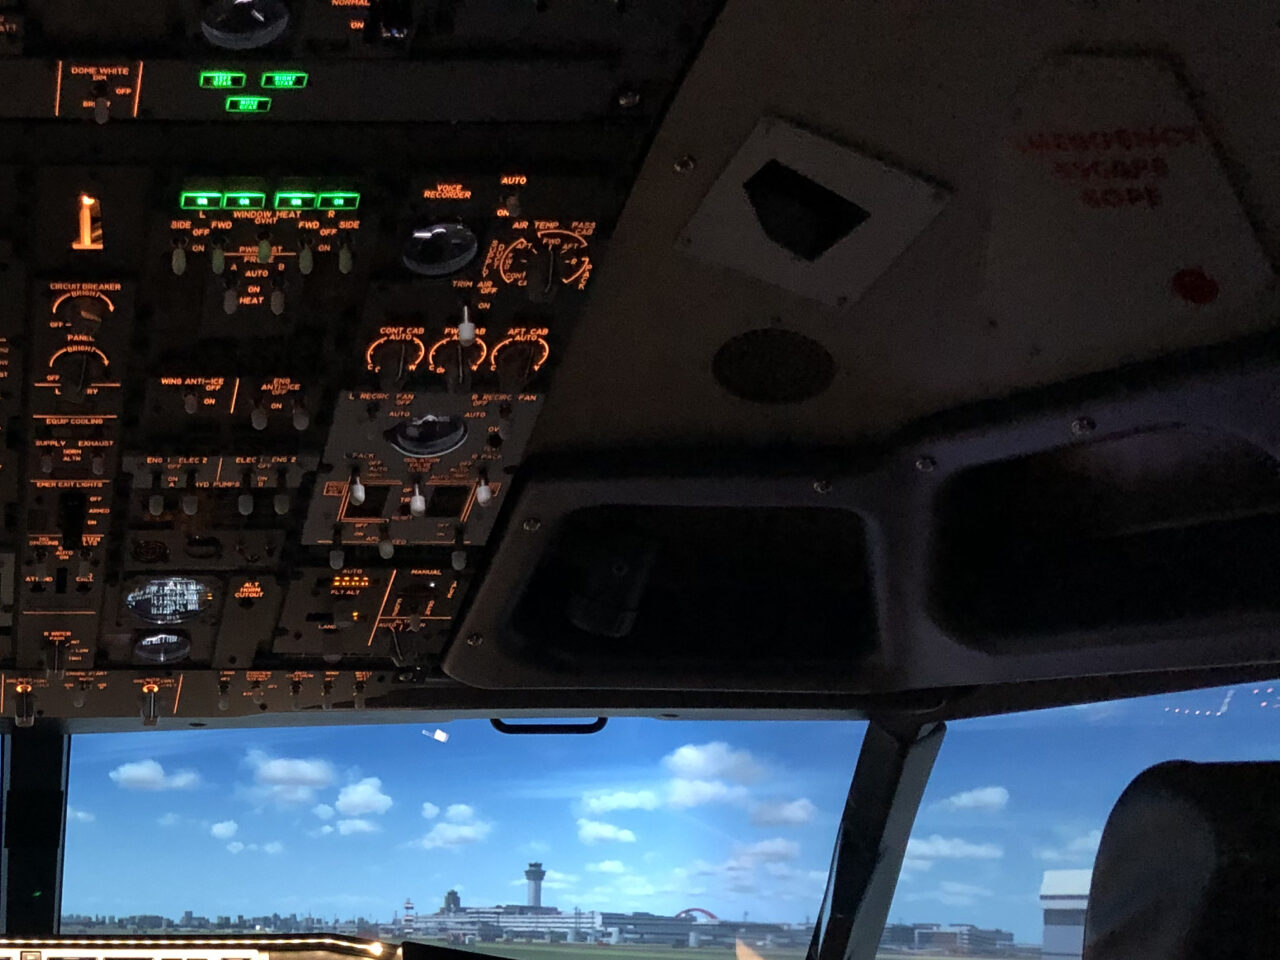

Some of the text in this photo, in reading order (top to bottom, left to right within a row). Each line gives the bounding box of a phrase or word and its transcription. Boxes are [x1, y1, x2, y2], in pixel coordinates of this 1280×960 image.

[71, 67, 129, 75] DOME WHITE
[501, 177, 527, 185] AUTO
[424, 190, 471, 199] RECORDER
[171, 221, 192, 229] SIDE
[212, 221, 232, 229] FWD
[298, 221, 320, 229] FWD
[339, 221, 360, 229] SIDE
[512, 221, 559, 229] AIR TEMP
[318, 244, 330, 252] ON
[82, 283, 121, 291] BREAKER
[239, 297, 264, 305] HEAT
[380, 327, 425, 335] CONT CAB
[507, 328, 549, 336] AFT CAB
